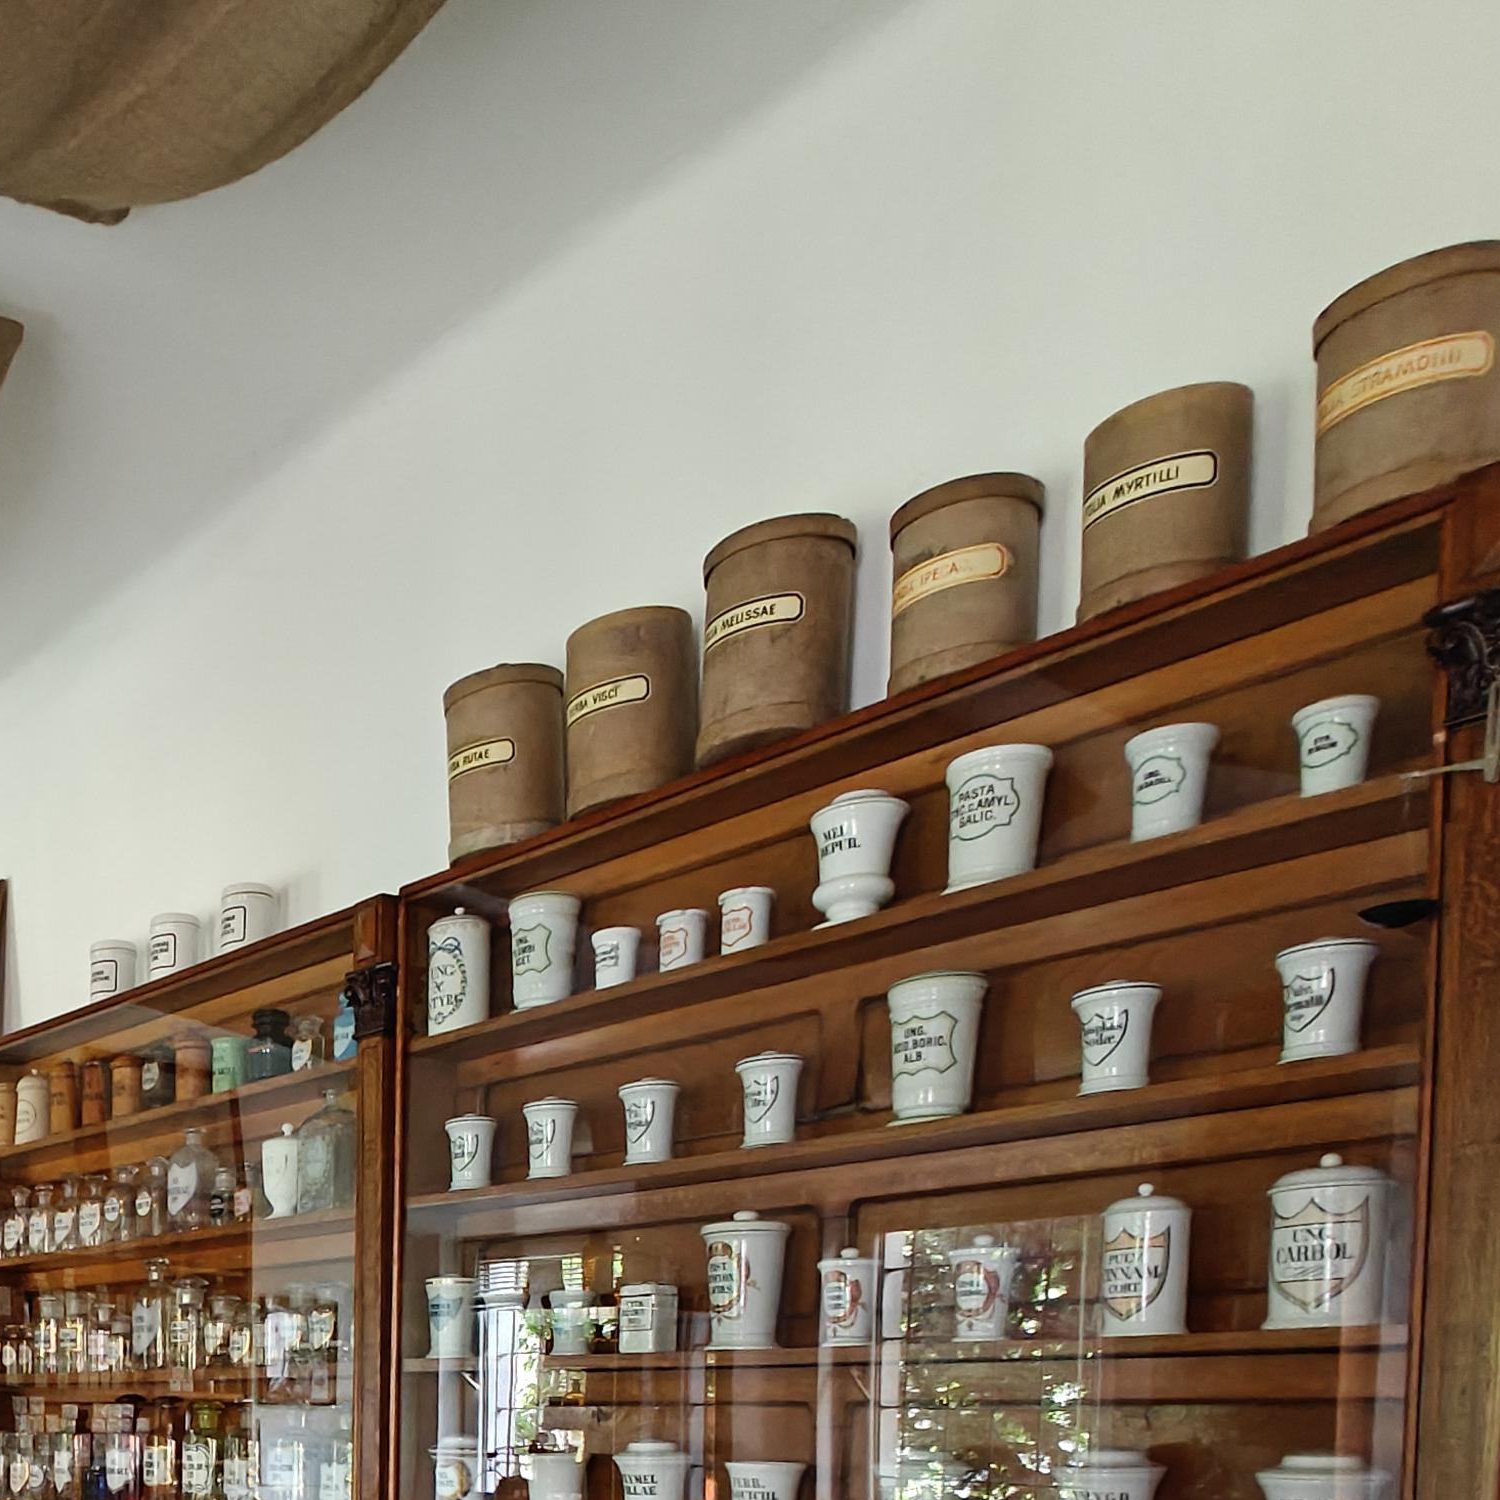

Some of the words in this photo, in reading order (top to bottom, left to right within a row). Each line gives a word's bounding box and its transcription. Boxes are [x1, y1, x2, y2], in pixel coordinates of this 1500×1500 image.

[1111, 465, 1180, 501] MYRTILLI
[721, 603, 777, 631] MELISSAE
[462, 748, 491, 766] RUTAE
[959, 784, 996, 801] PASTA
